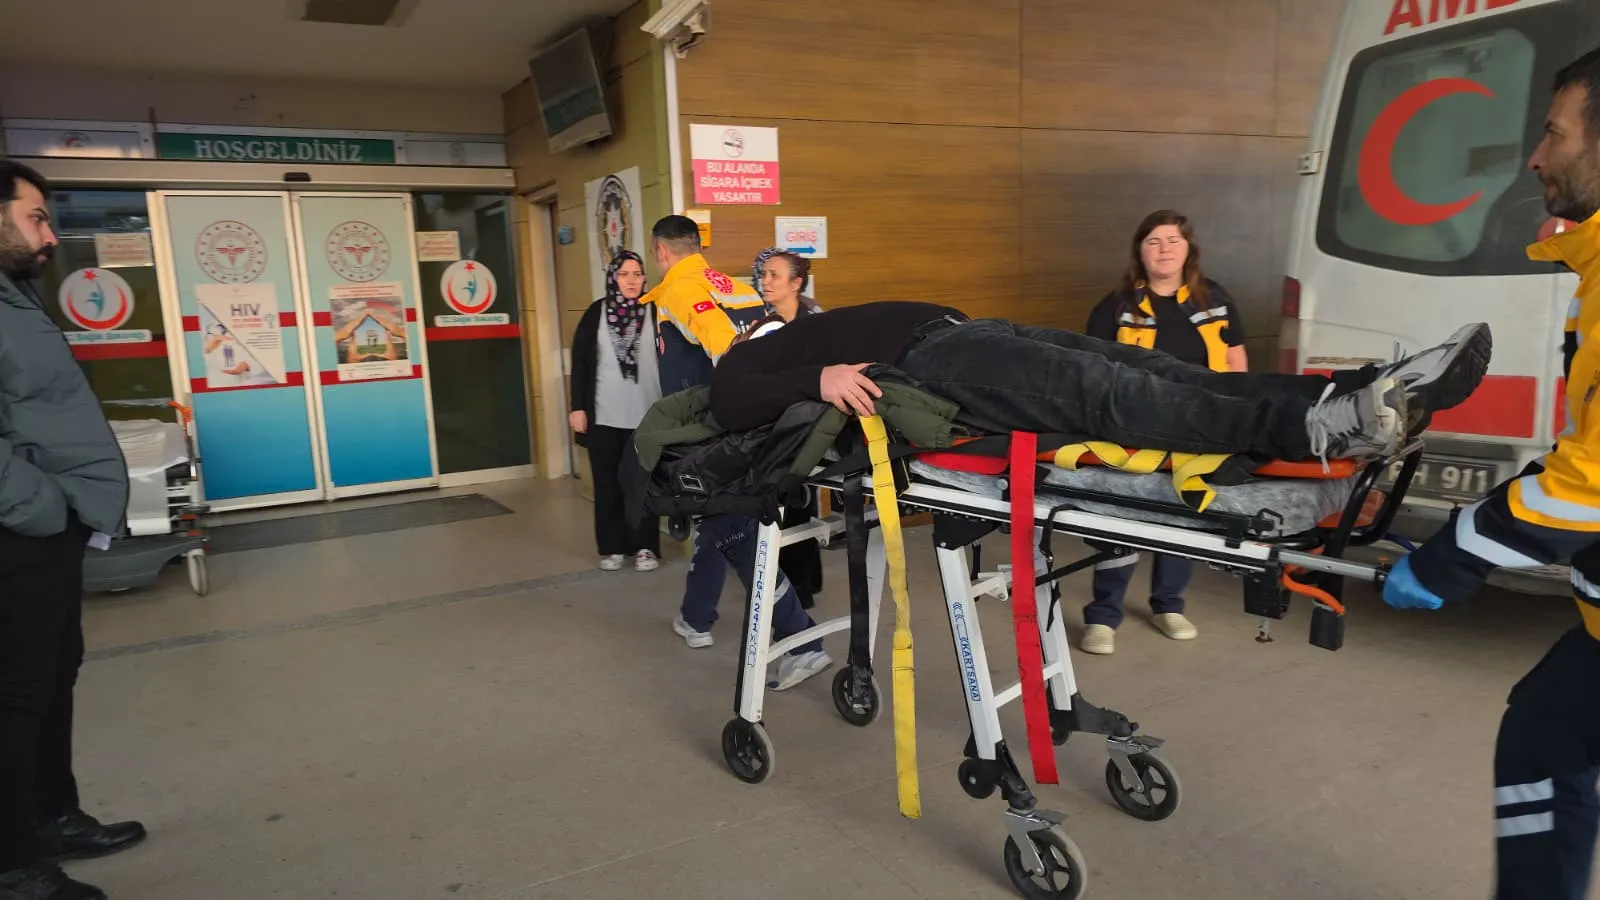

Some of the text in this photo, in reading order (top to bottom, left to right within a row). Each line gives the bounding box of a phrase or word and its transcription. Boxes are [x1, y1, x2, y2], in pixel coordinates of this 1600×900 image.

[194, 139, 363, 162] HOŞGELDİNİZ
[707, 161, 766, 174] BU ALANDA
[700, 174, 773, 190] SİGARA İÇMEK
[712, 191, 762, 203] YASAKTIR
[785, 229, 817, 245] GİRİŞ
[231, 303, 260, 317] HIV
[1440, 465, 1488, 493] 911
[961, 640, 981, 700] KARTSANA
